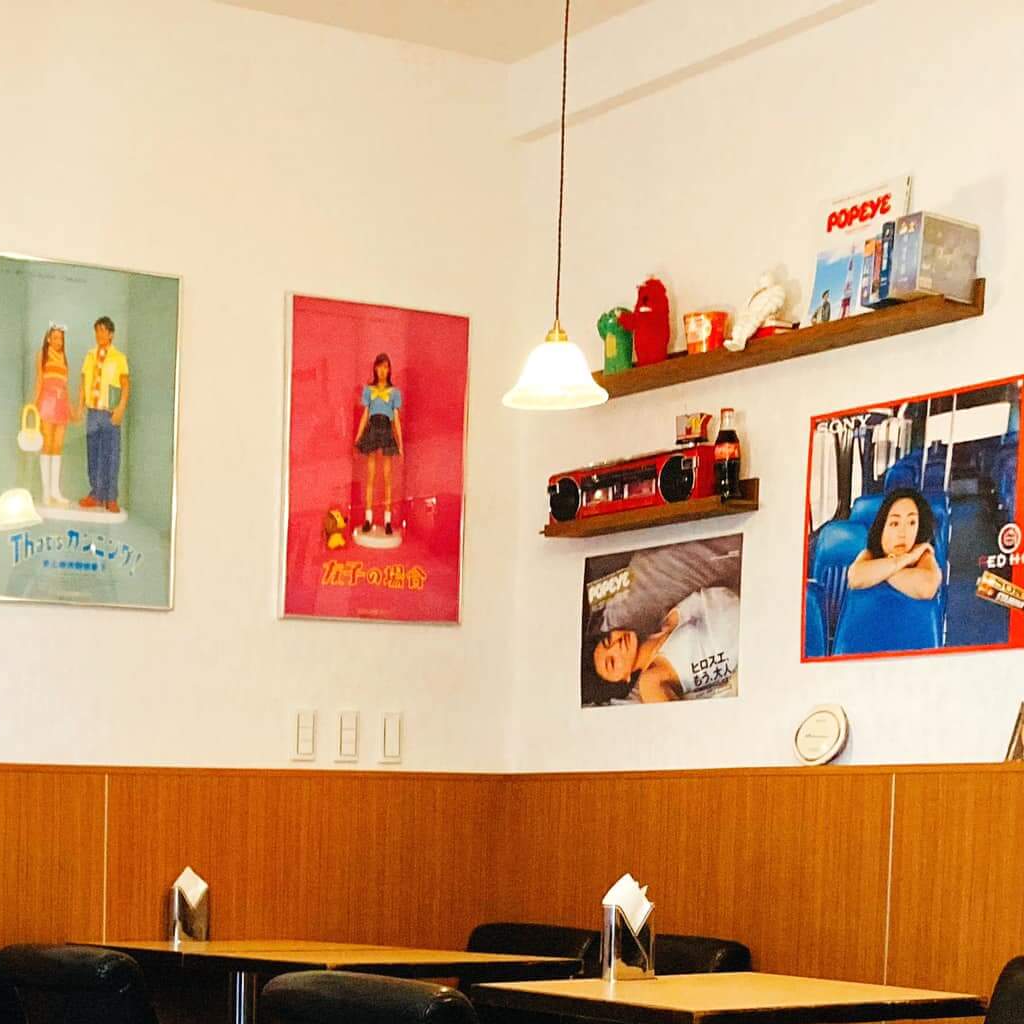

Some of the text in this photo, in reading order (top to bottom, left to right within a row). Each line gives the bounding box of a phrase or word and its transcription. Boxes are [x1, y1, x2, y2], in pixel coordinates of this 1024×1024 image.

[826, 192, 892, 232] POPEYE
[816, 413, 872, 434] SONY
[1010, 552, 1024, 566] H
